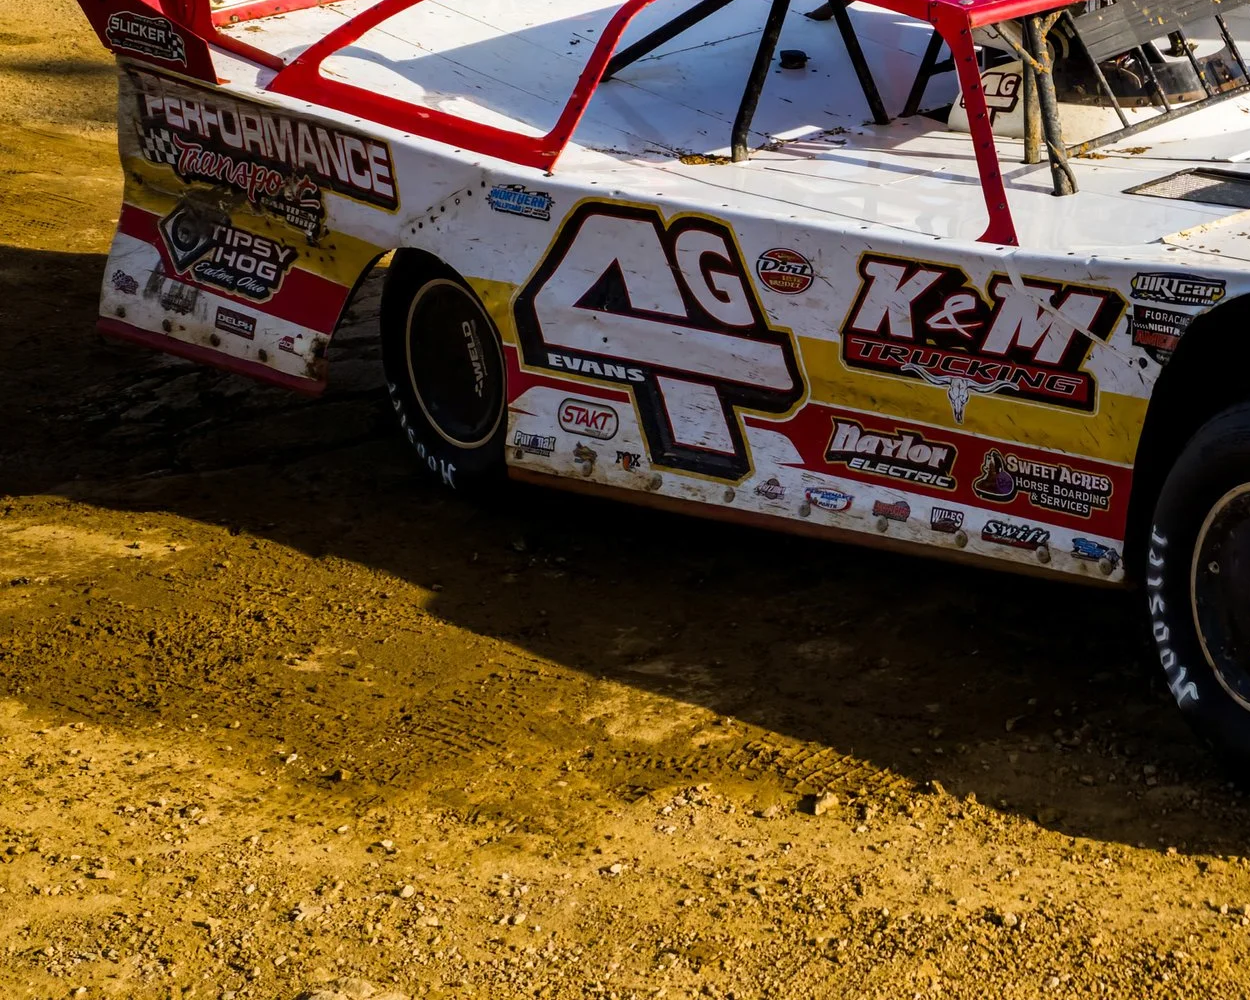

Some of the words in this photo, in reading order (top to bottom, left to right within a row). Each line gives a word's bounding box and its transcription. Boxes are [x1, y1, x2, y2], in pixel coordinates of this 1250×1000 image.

[111, 17, 166, 44] SLICKER
[145, 94, 394, 199] PERFORMANCE
[211, 224, 291, 263] TIPSY
[215, 247, 278, 281] HOG
[236, 276, 266, 294] Ohio
[547, 353, 646, 382] EVANS
[851, 338, 1084, 396] TRUCKING
[562, 405, 619, 430] STAKT
[849, 457, 953, 487] ELECTRIC
[1006, 455, 1059, 480] SWEET
[1059, 466, 1110, 492] ACRES
[1015, 476, 1051, 493] HORSE
[1053, 484, 1107, 506] BOARDING
[1041, 494, 1089, 514] SERVICES
[931, 508, 964, 528] WILES
[1148, 525, 1200, 708] Hoosier
